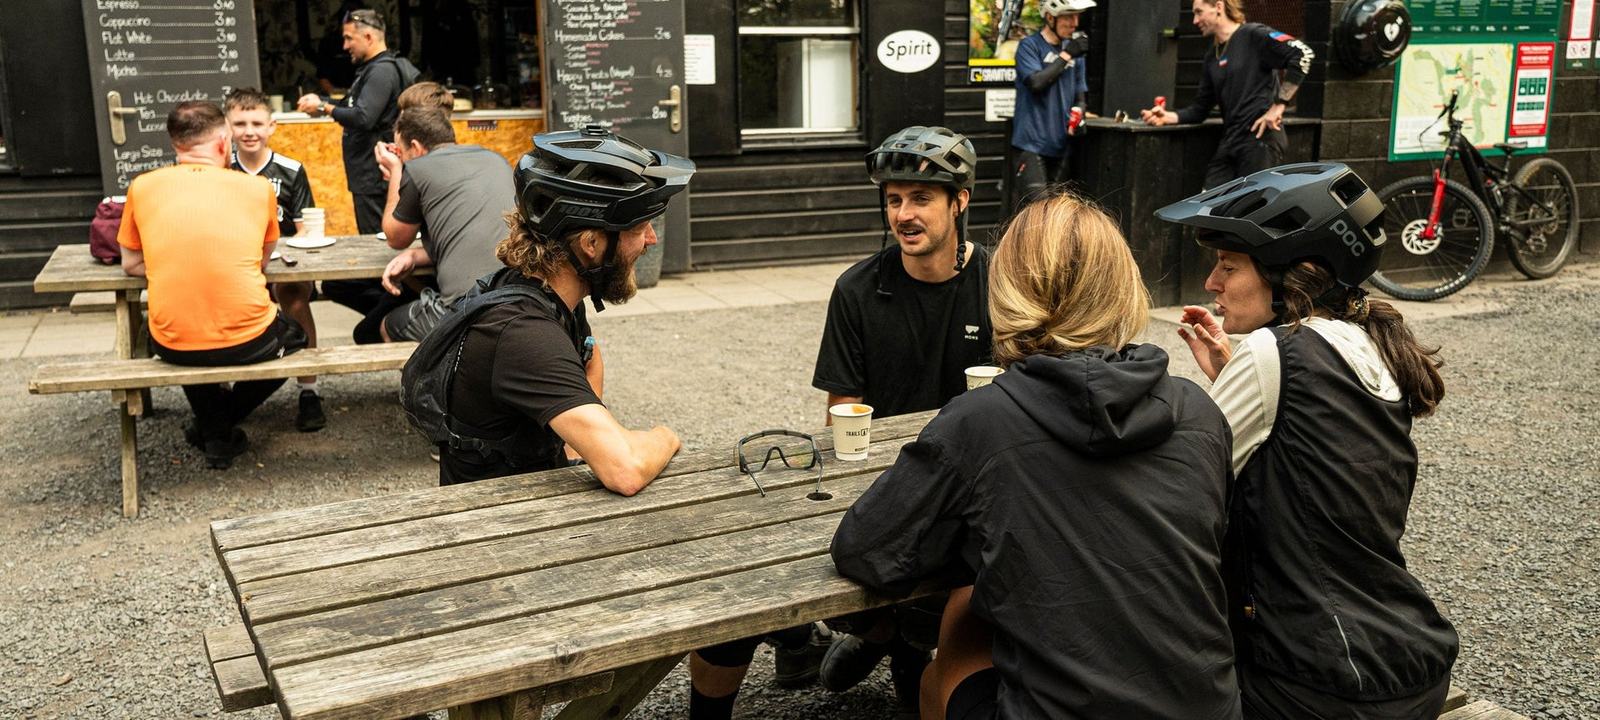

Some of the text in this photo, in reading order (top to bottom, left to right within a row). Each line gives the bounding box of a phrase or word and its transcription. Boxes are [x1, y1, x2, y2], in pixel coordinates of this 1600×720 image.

[99, 13, 151, 30] Cappuccino
[102, 31, 123, 45] Flat
[126, 30, 152, 44] White
[554, 29, 598, 44] Homemade
[598, 28, 626, 41] Cakes
[104, 48, 135, 61] Latte
[886, 40, 932, 60] Spirit
[106, 64, 138, 79] Mocha
[556, 69, 583, 84] Happy
[582, 67, 609, 79] Treats
[134, 91, 154, 104] Hot
[157, 89, 208, 103] Chocolate
[138, 106, 156, 119] Tea
[113, 144, 163, 162] Large Size
[1330, 219, 1365, 257] POC
